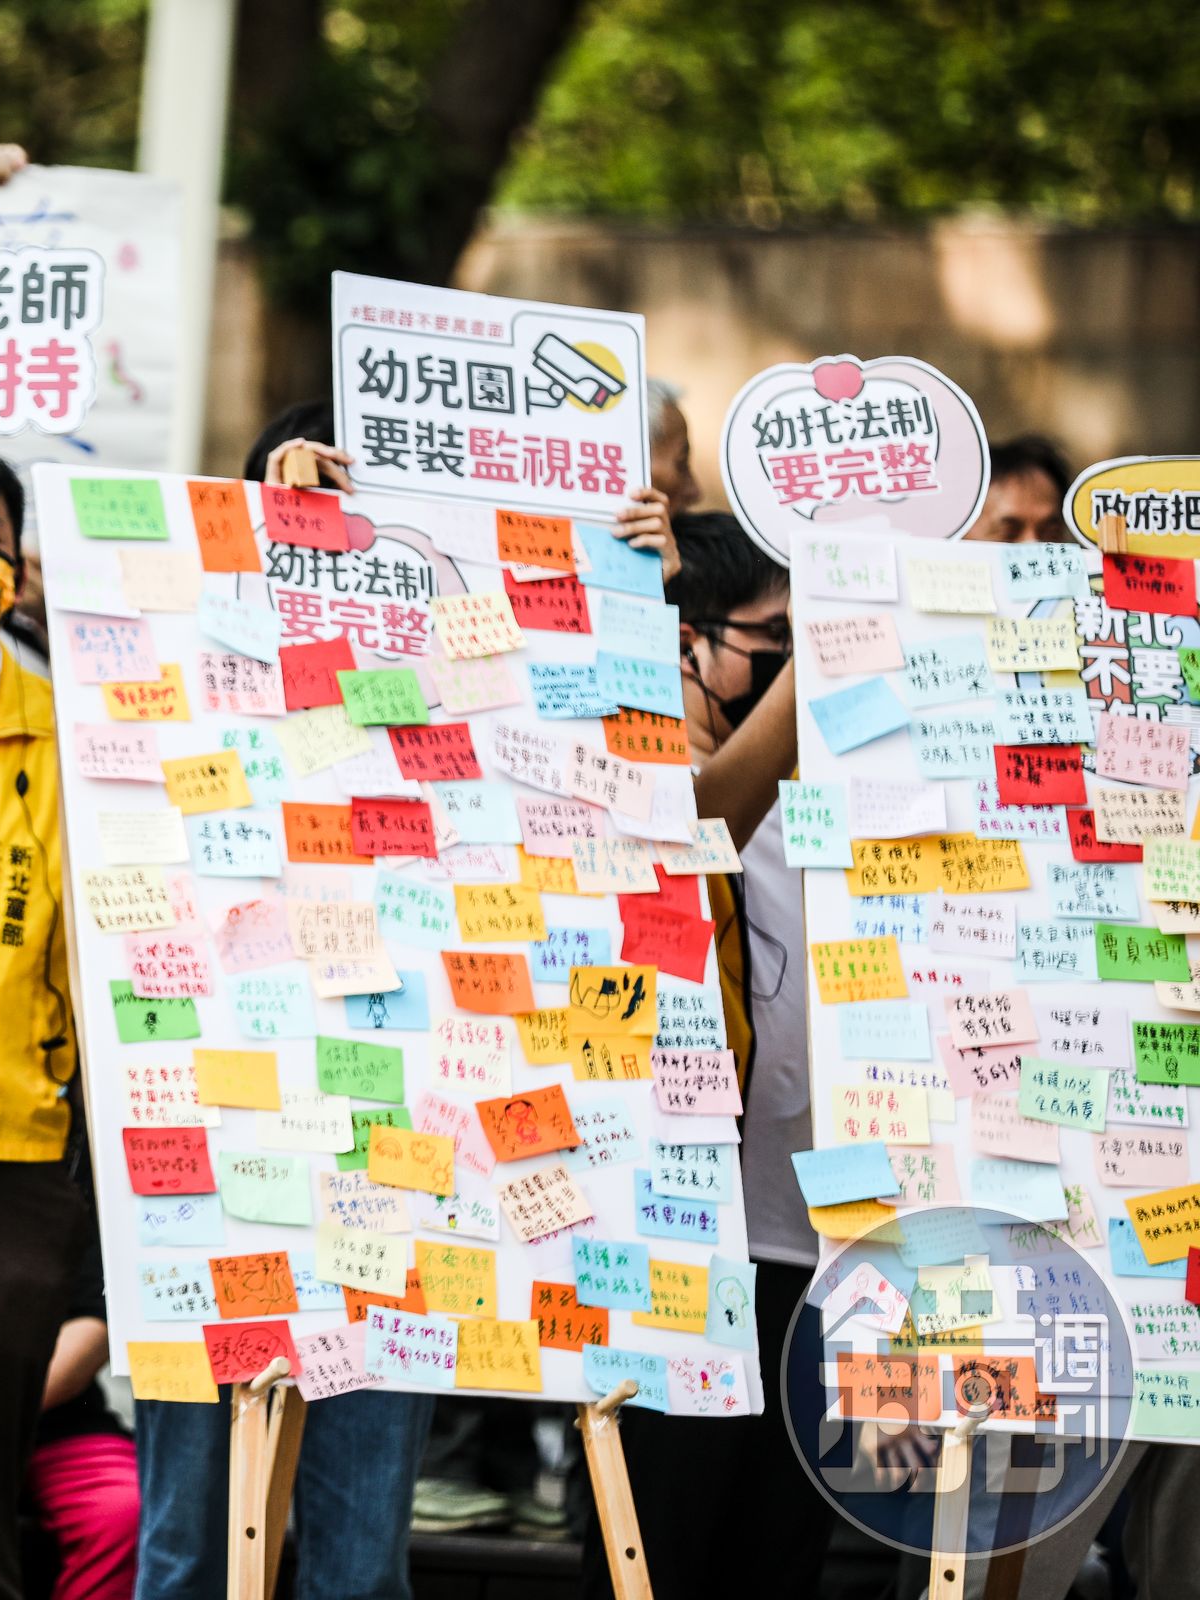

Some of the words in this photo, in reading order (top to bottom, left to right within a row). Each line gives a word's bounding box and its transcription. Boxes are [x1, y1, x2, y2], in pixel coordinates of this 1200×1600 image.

[350, 305, 505, 338] #監視器不要黑畫面
[358, 347, 516, 415] 幼兒園
[752, 395, 935, 451] 幼托法制
[361, 414, 628, 496] 要裝監視器
[768, 442, 939, 506] 要完整
[1093, 493, 1200, 531] 政府把
[266, 540, 435, 601] 幼托法制
[275, 587, 432, 657] 要完整
[1079, 645, 1185, 700] 不要
[1, 844, 33, 948] 新北黨部
[1102, 932, 1182, 966] 要真相!!
